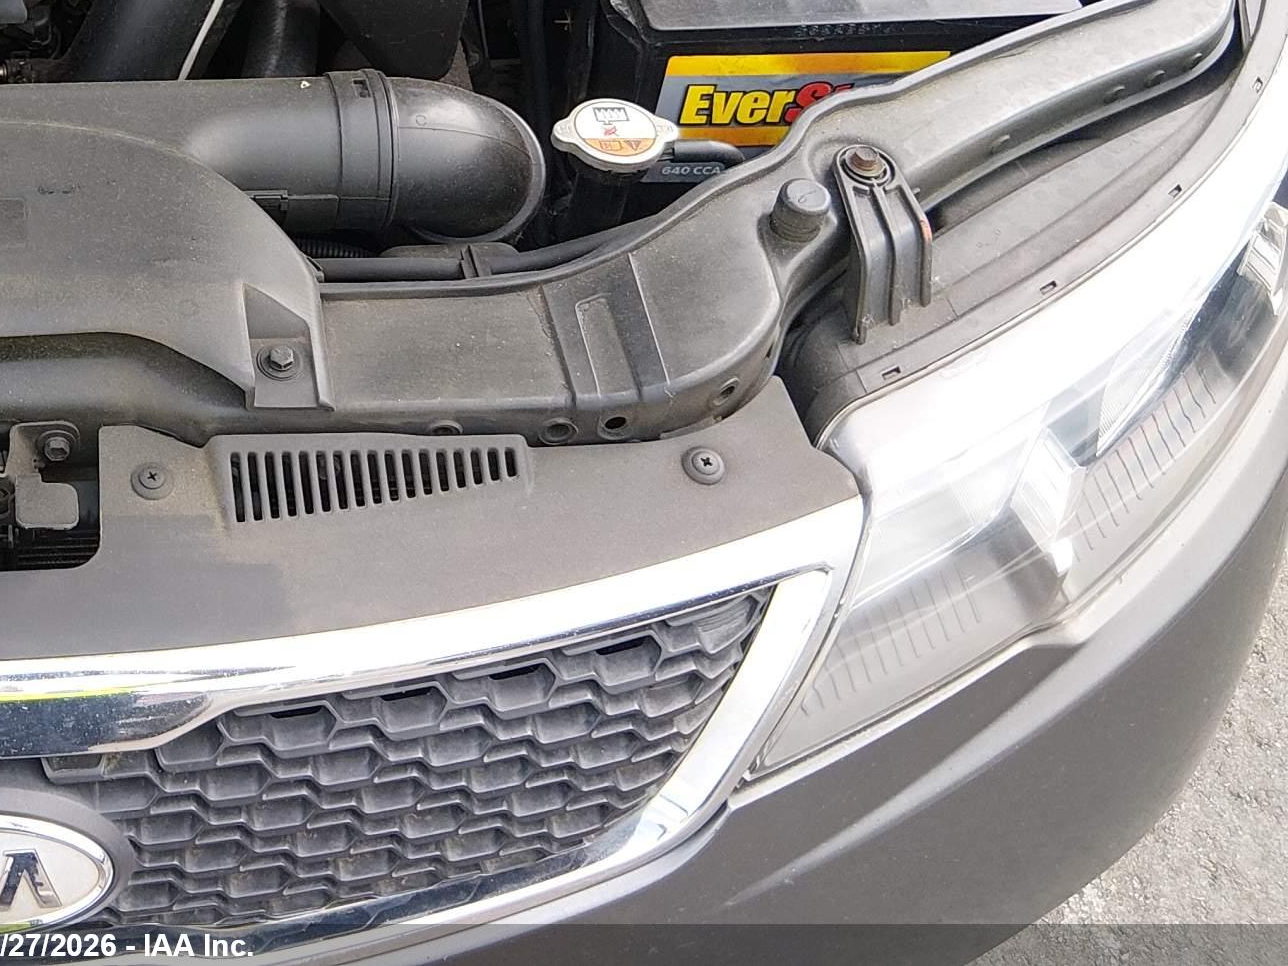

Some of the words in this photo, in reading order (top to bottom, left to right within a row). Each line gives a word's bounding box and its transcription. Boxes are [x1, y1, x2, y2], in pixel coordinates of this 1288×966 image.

[679, 81, 854, 126] EverS
[662, 166, 690, 175] 640
[693, 166, 721, 175] CCA
